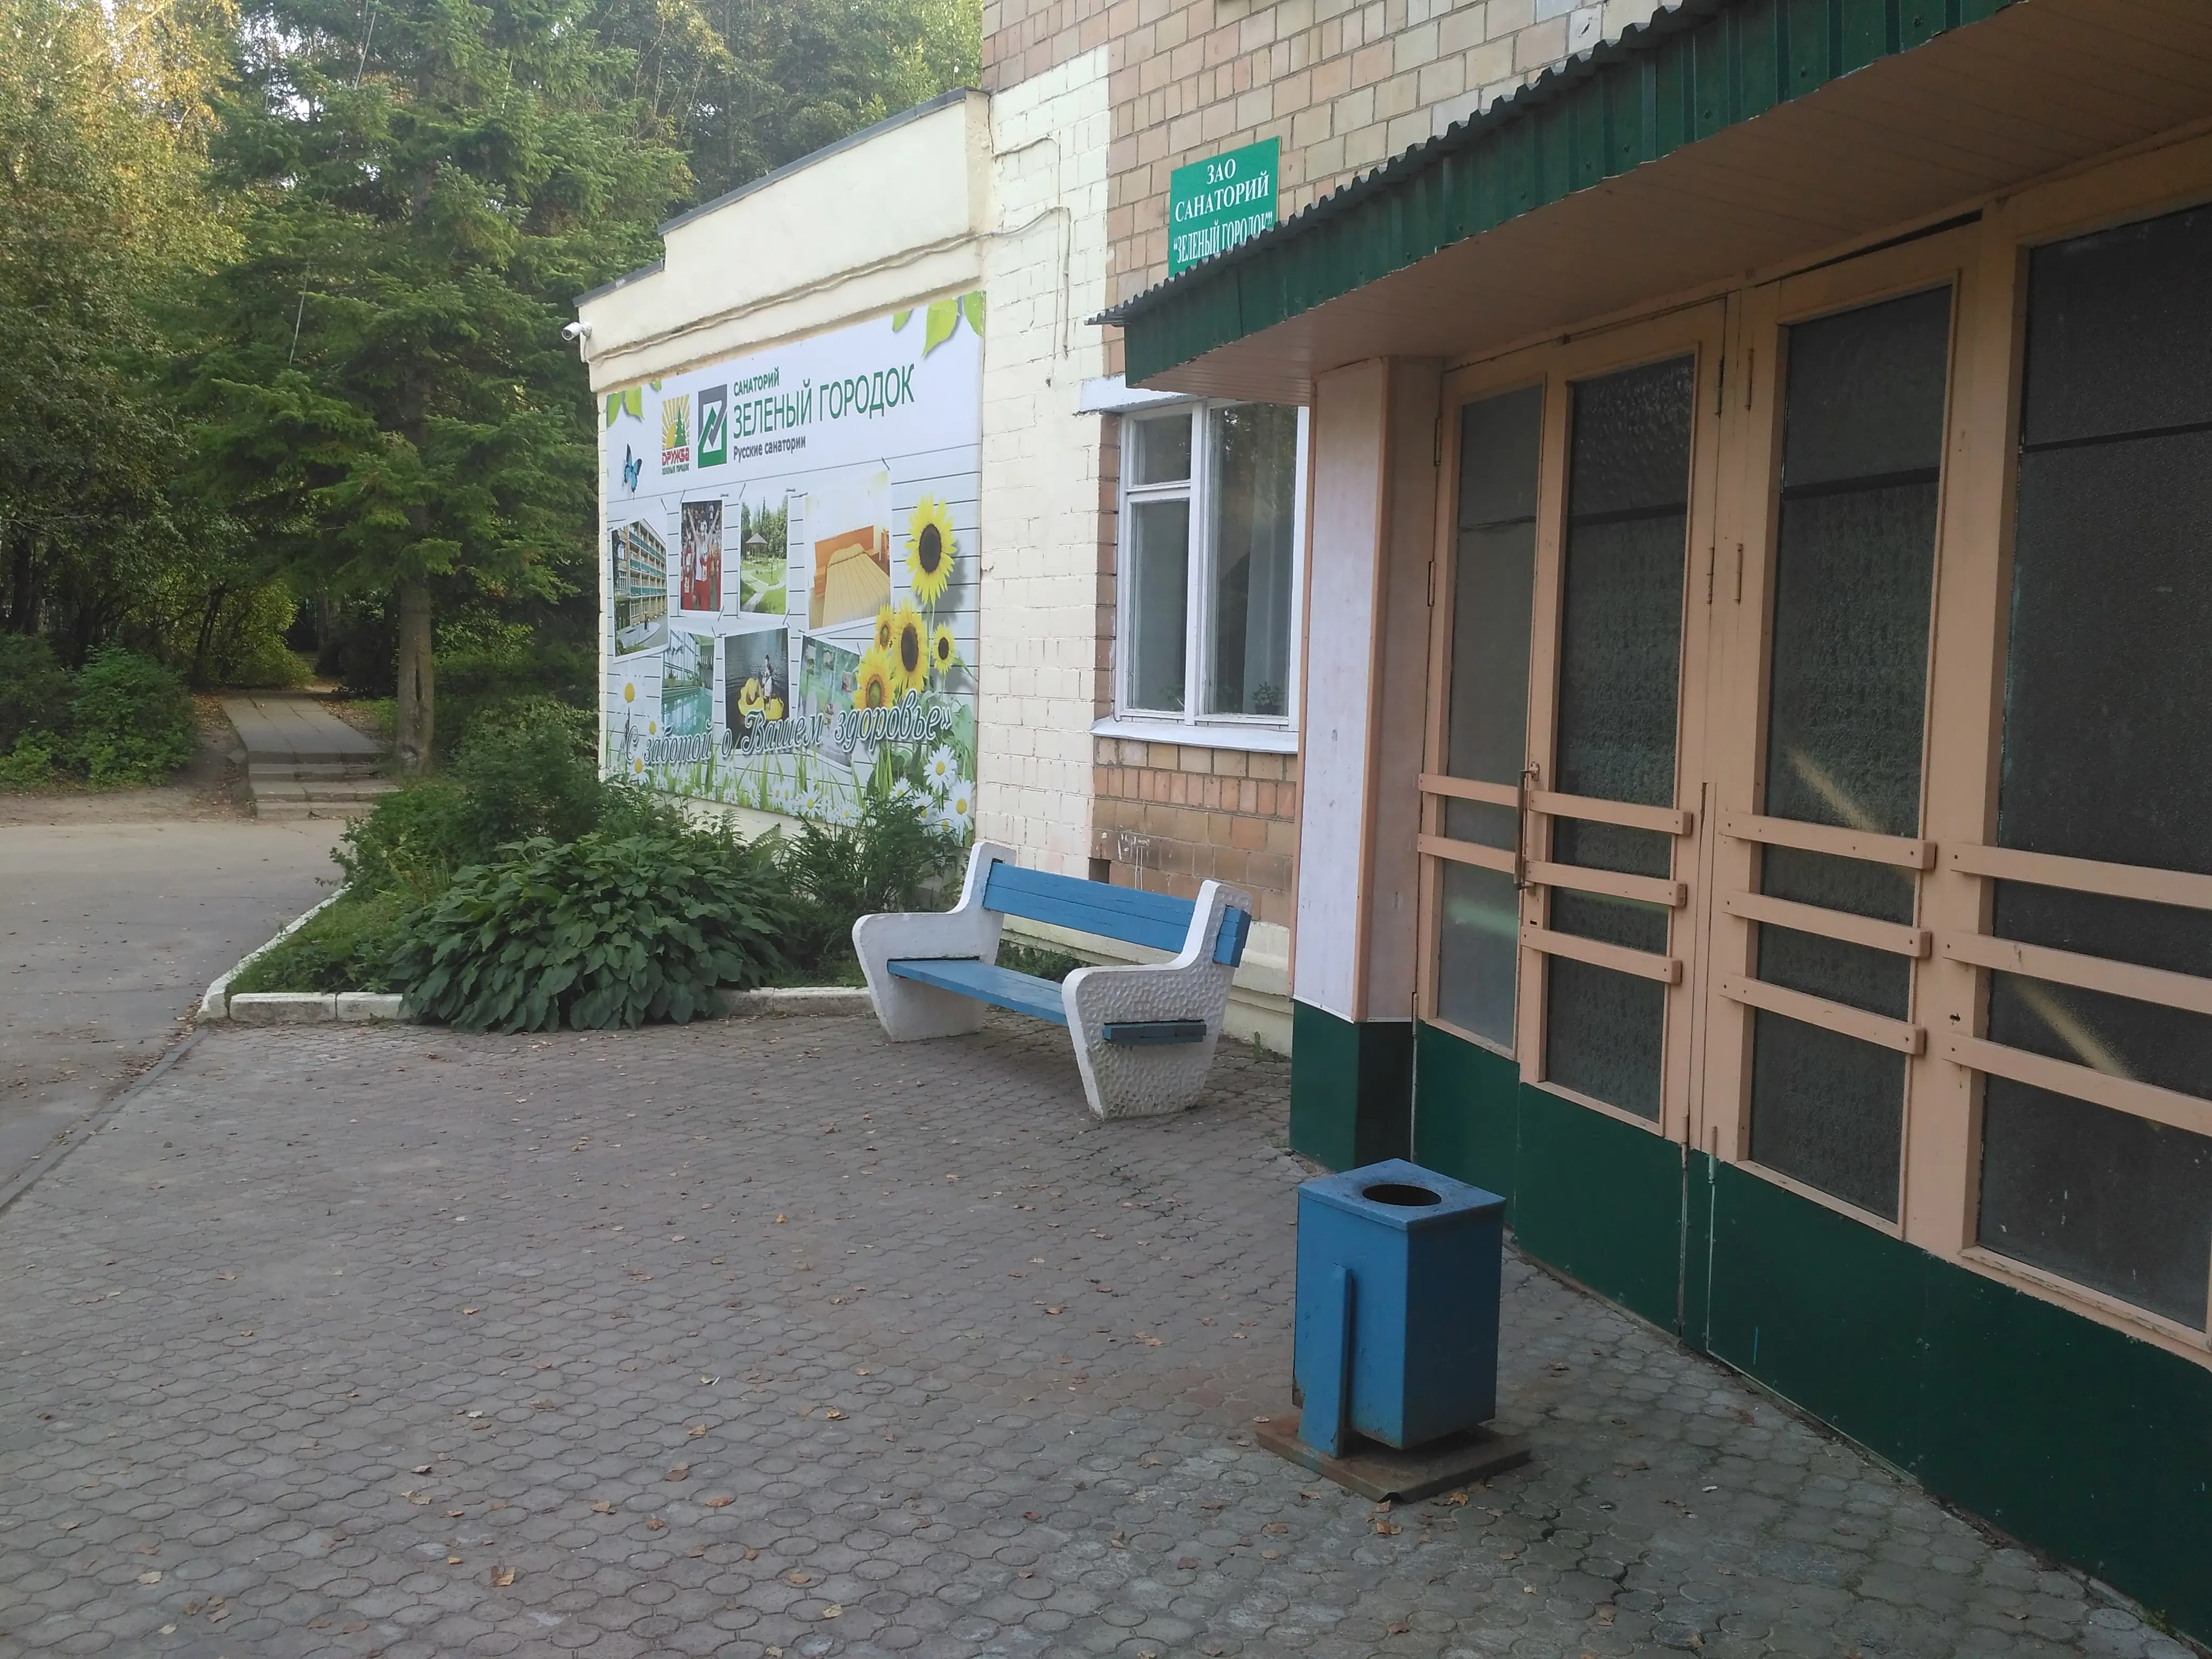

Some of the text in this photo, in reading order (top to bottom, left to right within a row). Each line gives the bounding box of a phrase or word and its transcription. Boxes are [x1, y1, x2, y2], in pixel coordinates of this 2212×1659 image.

[1207, 158, 1236, 185] ЗАО
[1175, 170, 1269, 222] САНАТОРИЙ
[733, 366, 780, 397] САНАТОРИЙ
[733, 363, 915, 439] ЗЕЛЕНЫЙ ГОРОДОК
[733, 435, 806, 463] Русские санатории
[643, 719, 713, 764] заботой
[721, 728, 733, 758] о
[741, 708, 824, 755] Вашем
